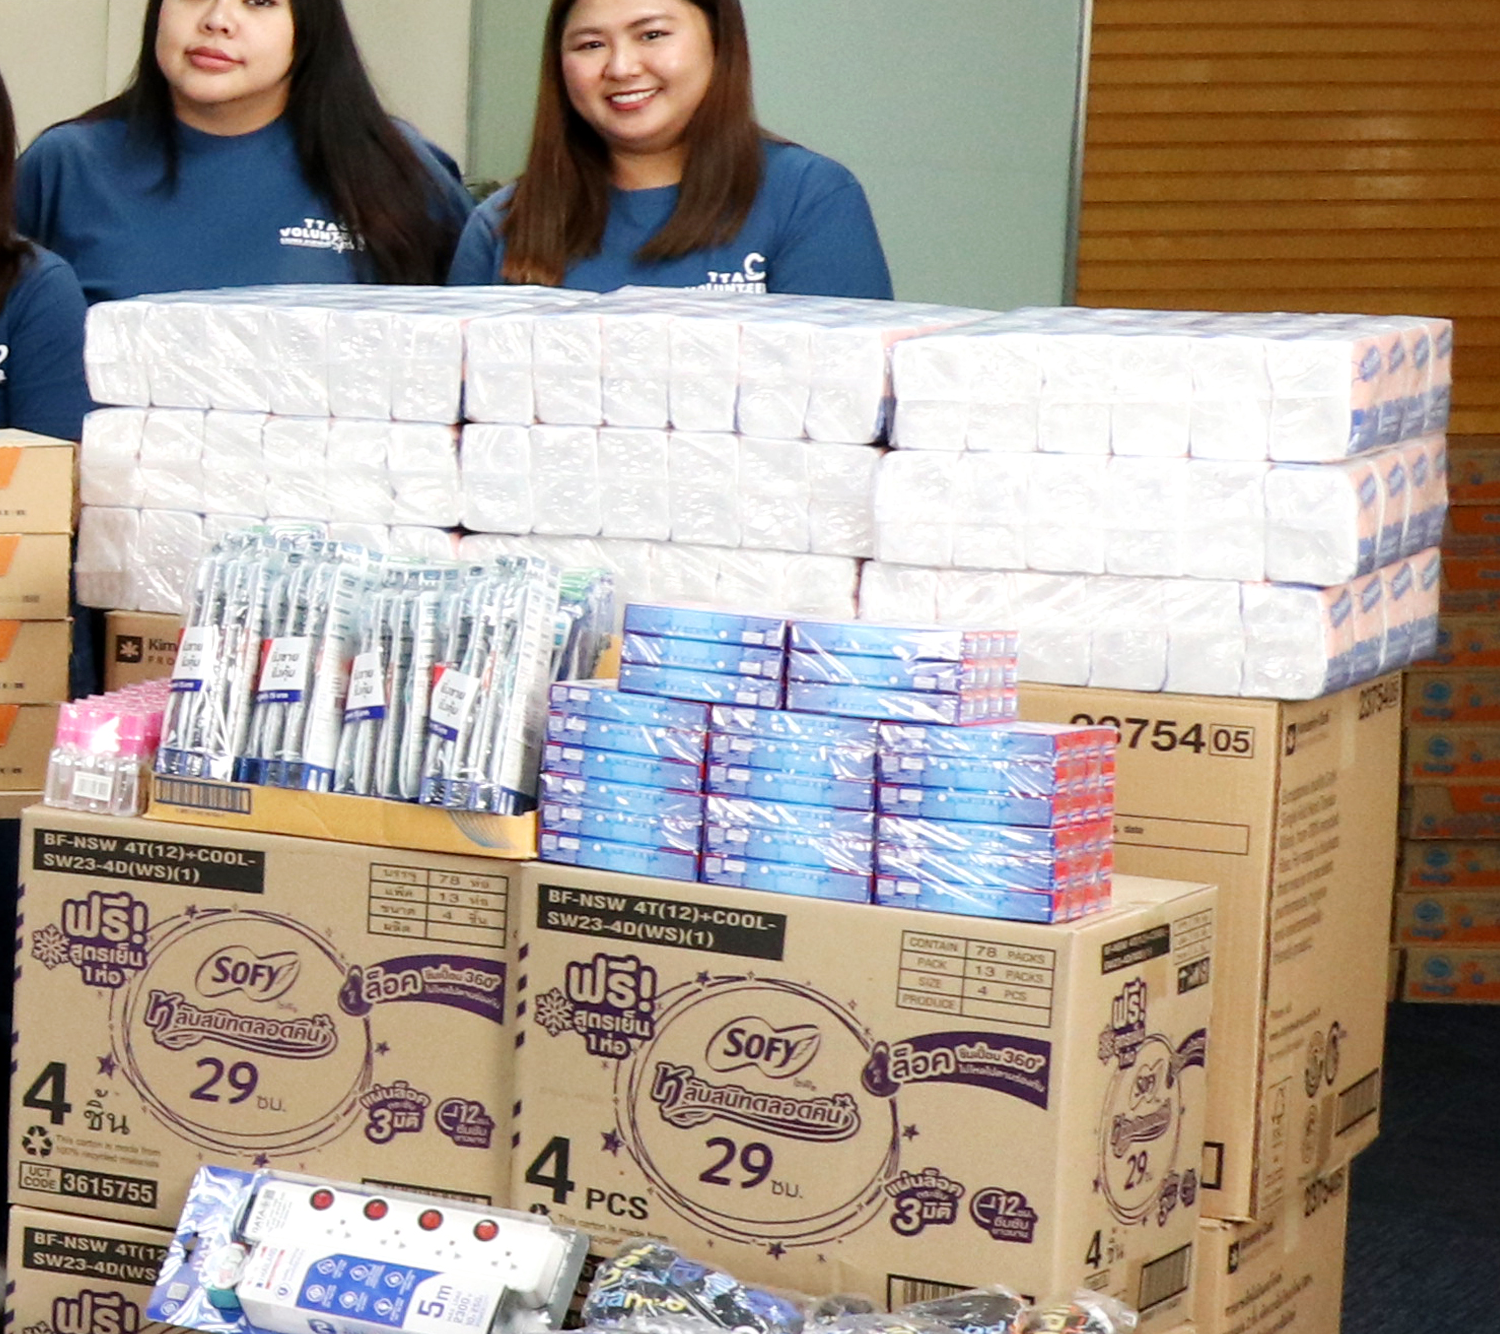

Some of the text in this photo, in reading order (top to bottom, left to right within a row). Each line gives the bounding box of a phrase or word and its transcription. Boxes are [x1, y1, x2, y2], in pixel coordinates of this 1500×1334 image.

[304, 218, 337, 230] TTA
[708, 271, 743, 284] TTA
[1069, 713, 1250, 754] 754 05
[43, 833, 256, 867] BF-NSW 4T(12)+COOL-
[43, 853, 200, 884] SW23-4D(WS)(1)
[64, 894, 146, 945] ฟรี!
[547, 911, 714, 947] SW23-4D(WS)(1)
[548, 890, 777, 931] BF-NSW 4T(12)+COOL-
[69, 942, 145, 968] สูตรเย็น
[975, 946, 997, 958] 78
[212, 956, 280, 992] SOFY
[567, 957, 654, 1012] ฟรี!
[146, 989, 330, 1044] หลับสนิทตลอดคืน
[573, 1008, 651, 1038] สูตรเย็น
[722, 1027, 796, 1068] SOFY
[22, 1061, 130, 1136] 4 ชิ้น
[189, 1056, 259, 1104] 29
[652, 1063, 850, 1123] หลับสนิทตลอดคืน
[525, 1136, 649, 1220] 4 PCS
[699, 1136, 773, 1189] 29
[62, 1172, 154, 1204] 3615755
